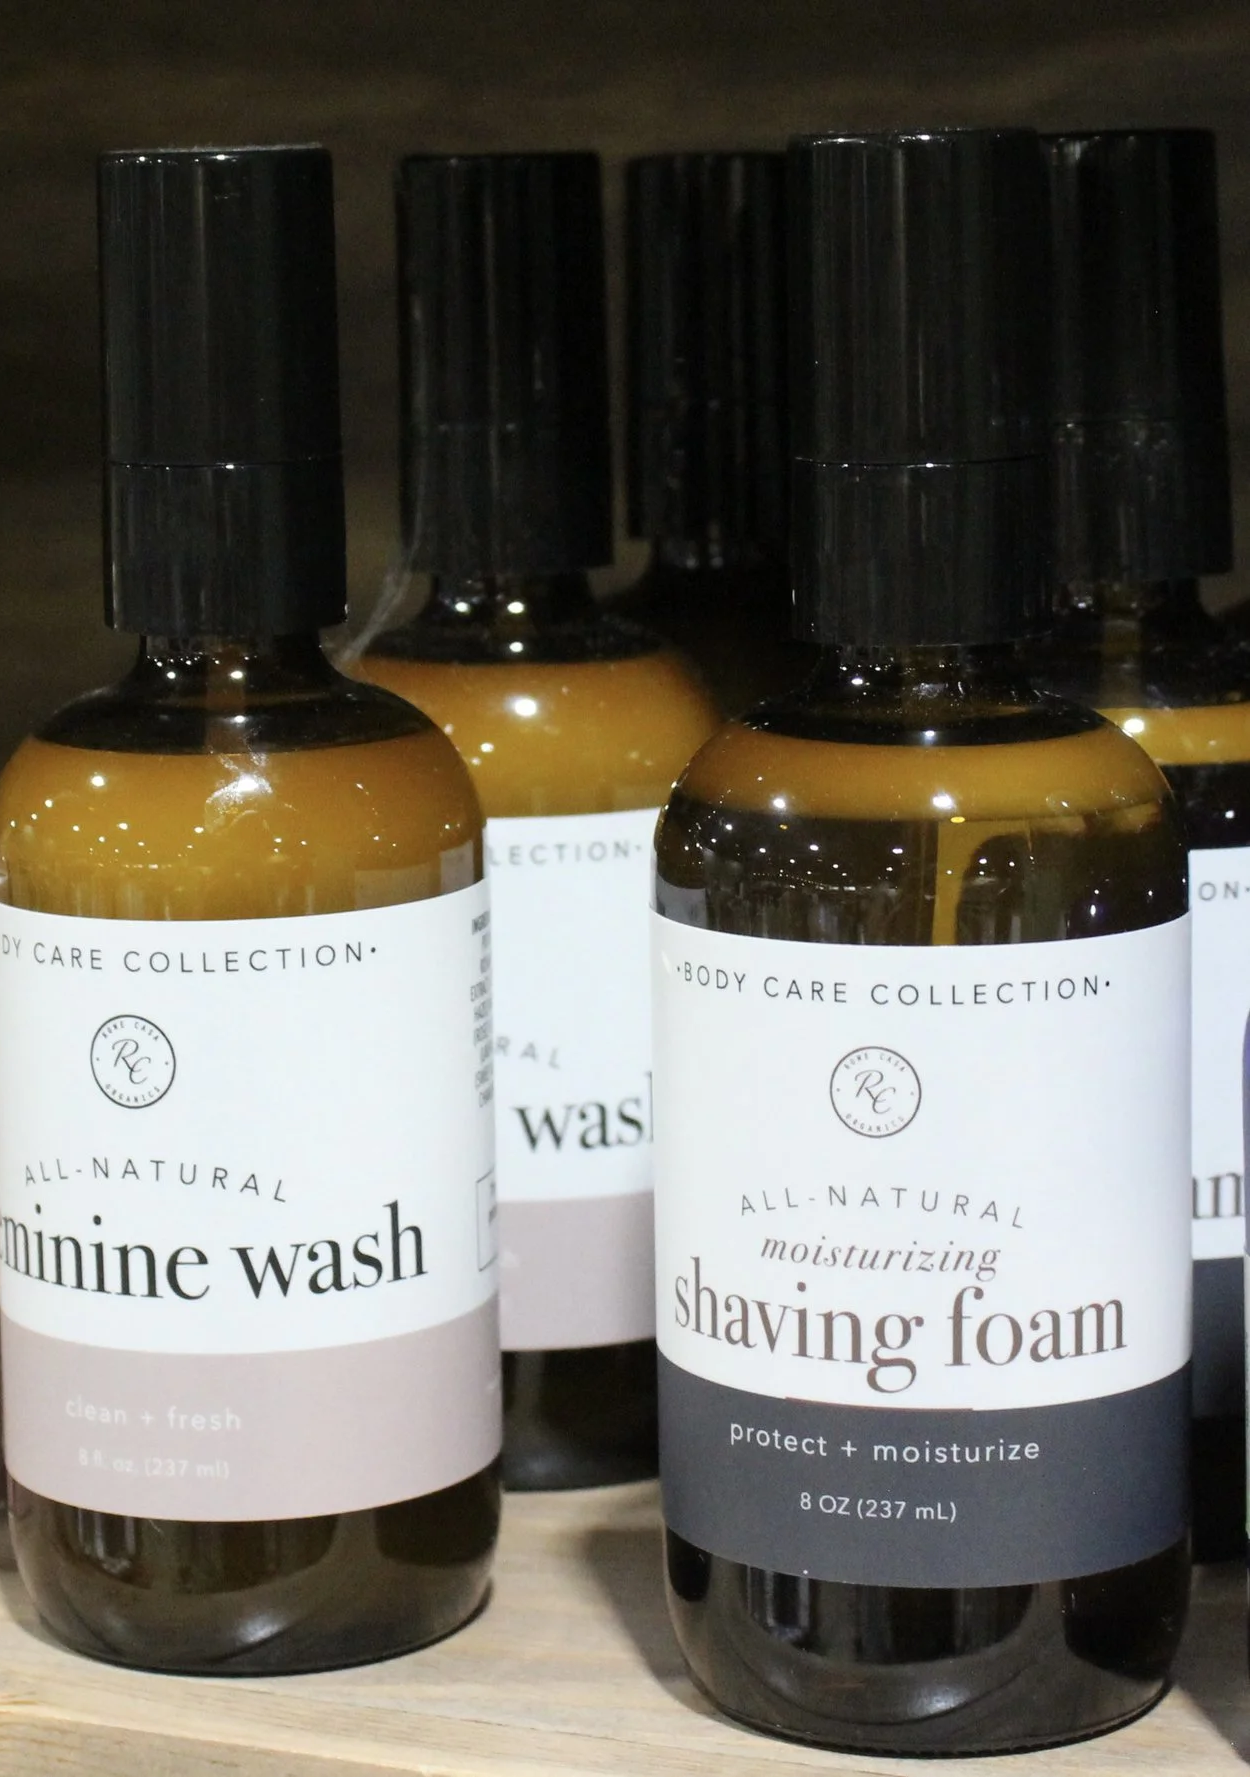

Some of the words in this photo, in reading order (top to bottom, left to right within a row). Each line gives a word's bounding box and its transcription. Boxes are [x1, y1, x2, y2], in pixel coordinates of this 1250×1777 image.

[33, 942, 102, 970] CARE
[763, 976, 847, 1004] CARE
[25, 1156, 286, 1203] ALL-NATURAL
[741, 1185, 1023, 1229] ALL-NATURAL
[230, 1200, 429, 1299] wash
[760, 1235, 1001, 1282] moisturizing
[674, 1256, 924, 1393] shaving
[945, 1285, 1128, 1367] foam
[65, 1395, 127, 1425] clean
[141, 1410, 154, 1426] +
[167, 1405, 241, 1431] fresh
[729, 1423, 827, 1456] protect
[841, 1440, 858, 1458] +
[873, 1439, 1040, 1463] moisturize
[78, 1448, 88, 1466] 8
[145, 1457, 189, 1477] (237
[196, 1460, 230, 1480] ml)
[800, 1492, 811, 1510] 8
[819, 1495, 851, 1516] OZ
[857, 1499, 906, 1520] (237
[916, 1502, 957, 1523] mL)
